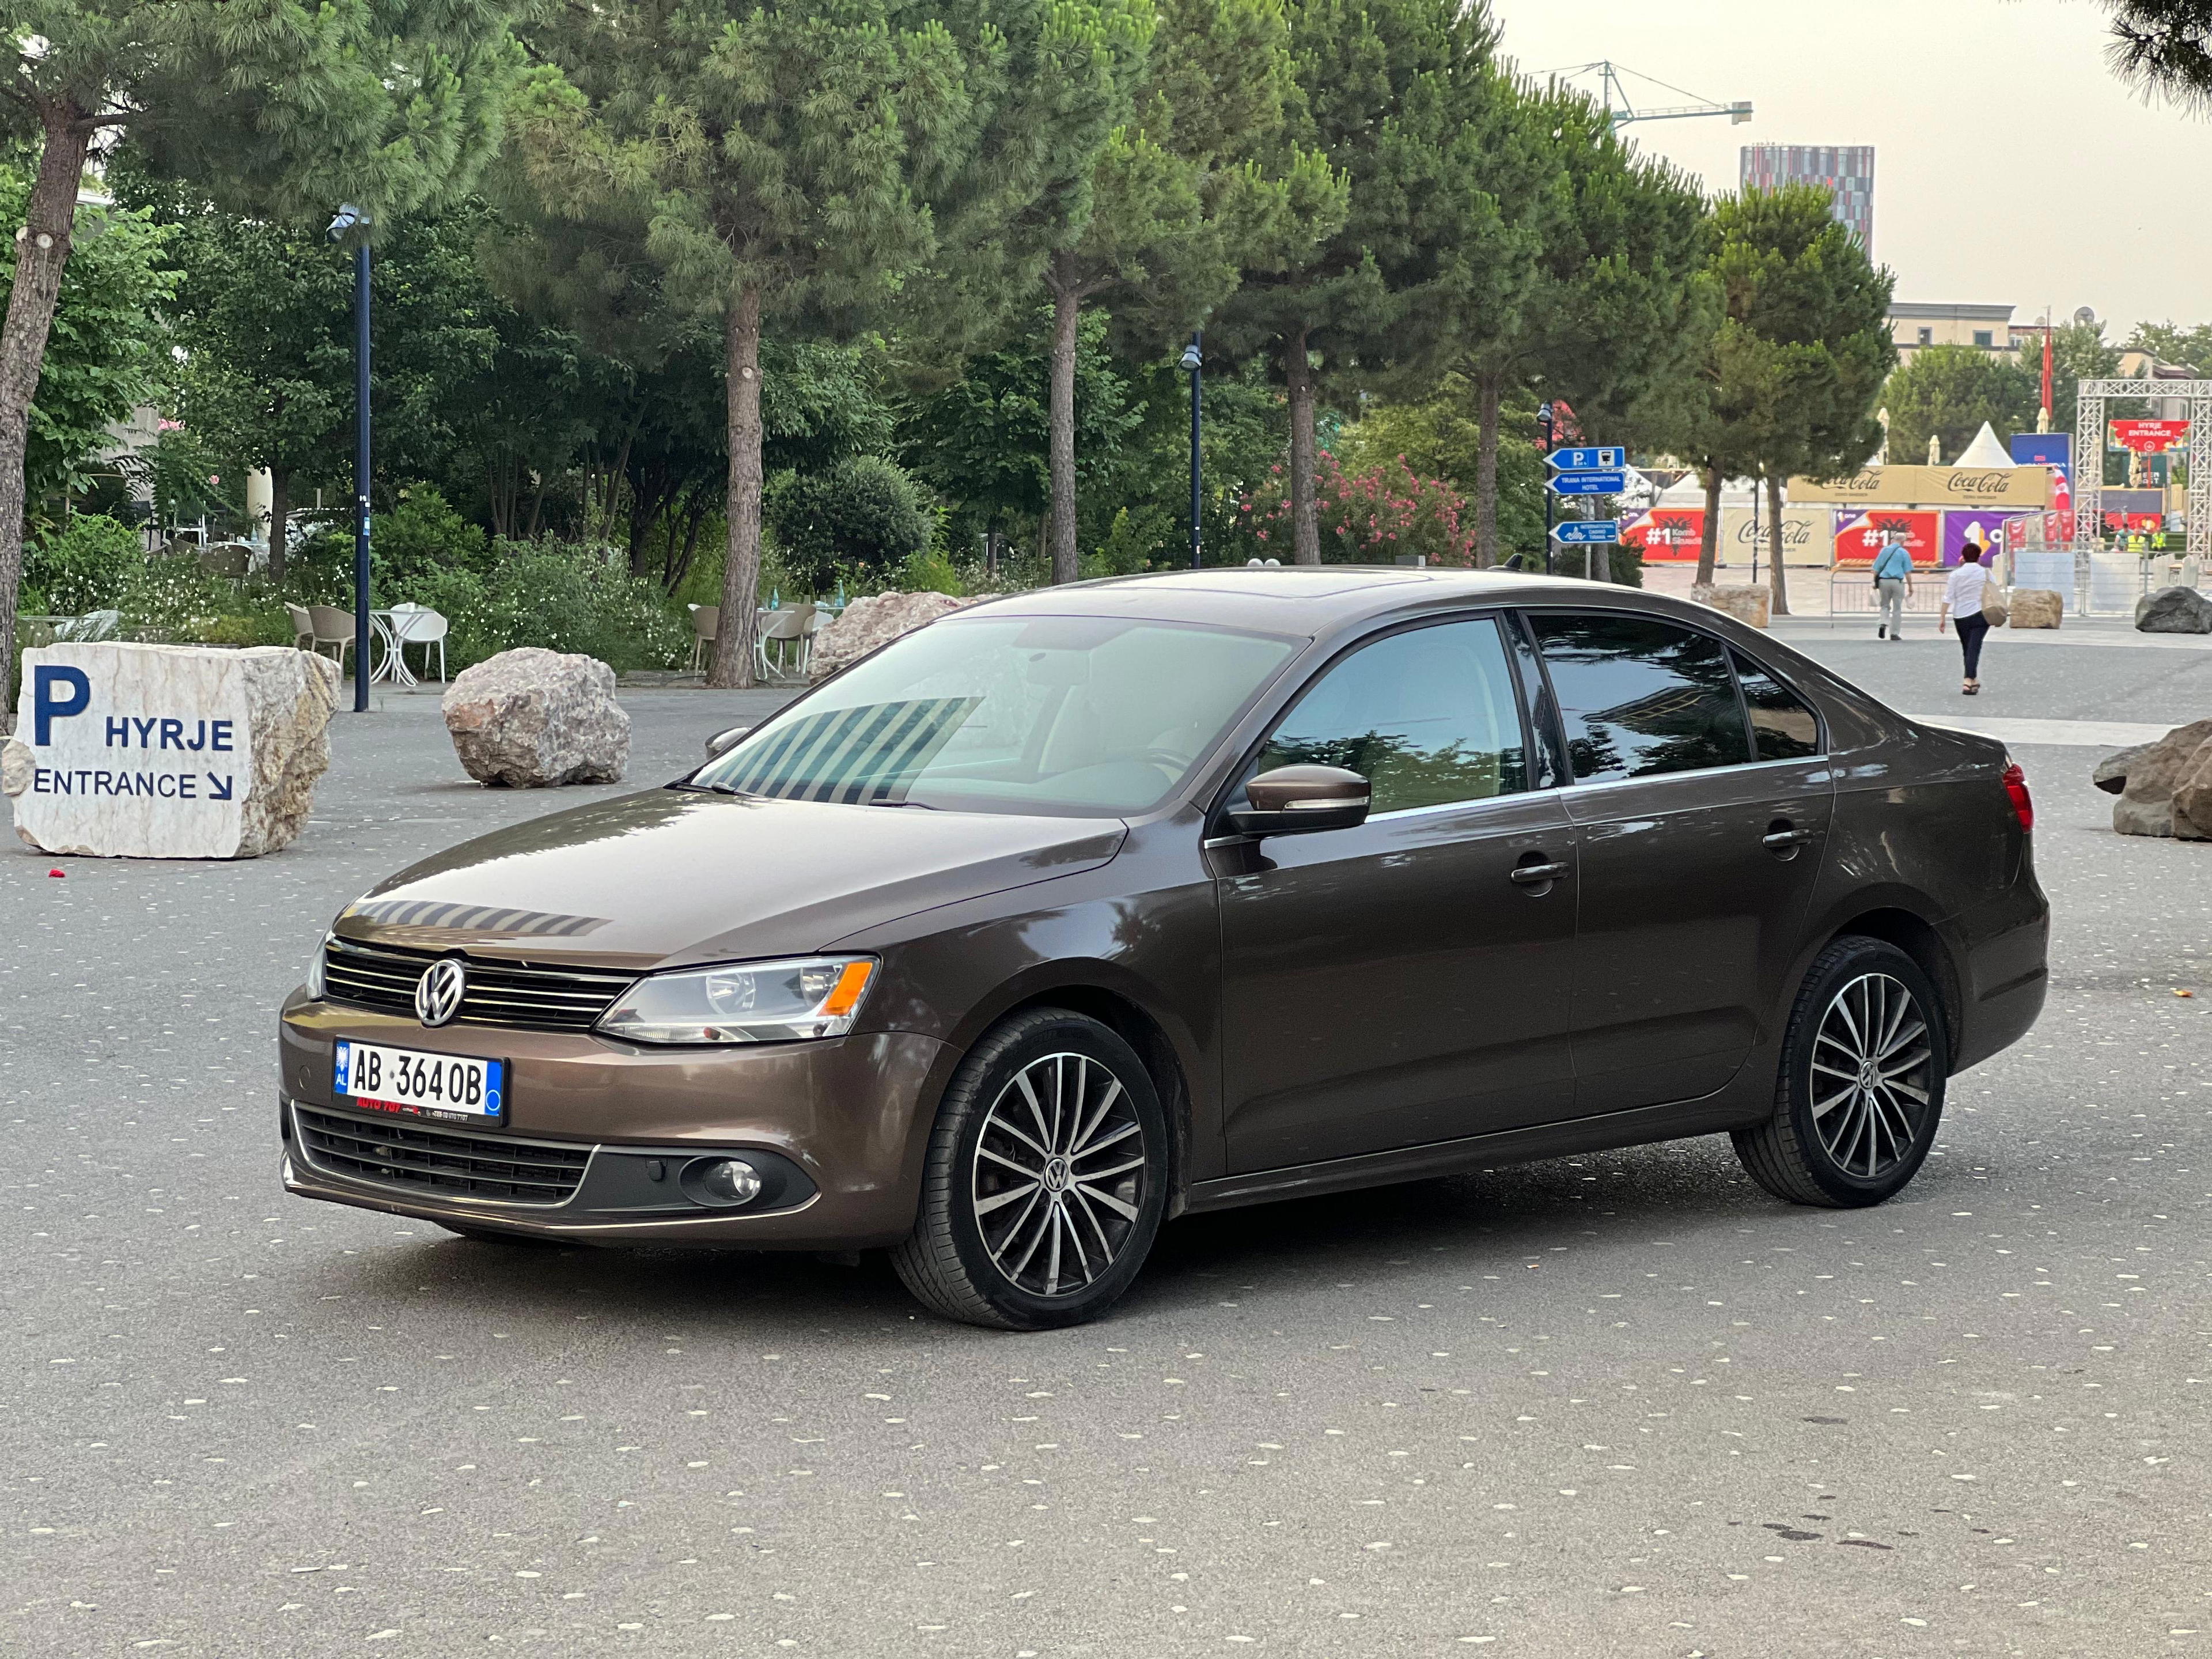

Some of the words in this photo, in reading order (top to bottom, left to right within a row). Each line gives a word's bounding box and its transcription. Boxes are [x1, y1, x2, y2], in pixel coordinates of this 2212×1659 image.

[1573, 452, 1584, 465] P
[1948, 472, 2013, 493] Coca-Cola
[35, 665, 90, 746] P
[105, 716, 233, 751] HYRJE
[33, 768, 196, 798] ENTRANCE
[335, 1072, 347, 1086] AL
[354, 1049, 381, 1092] AB
[357, 1097, 381, 1111] AUTO
